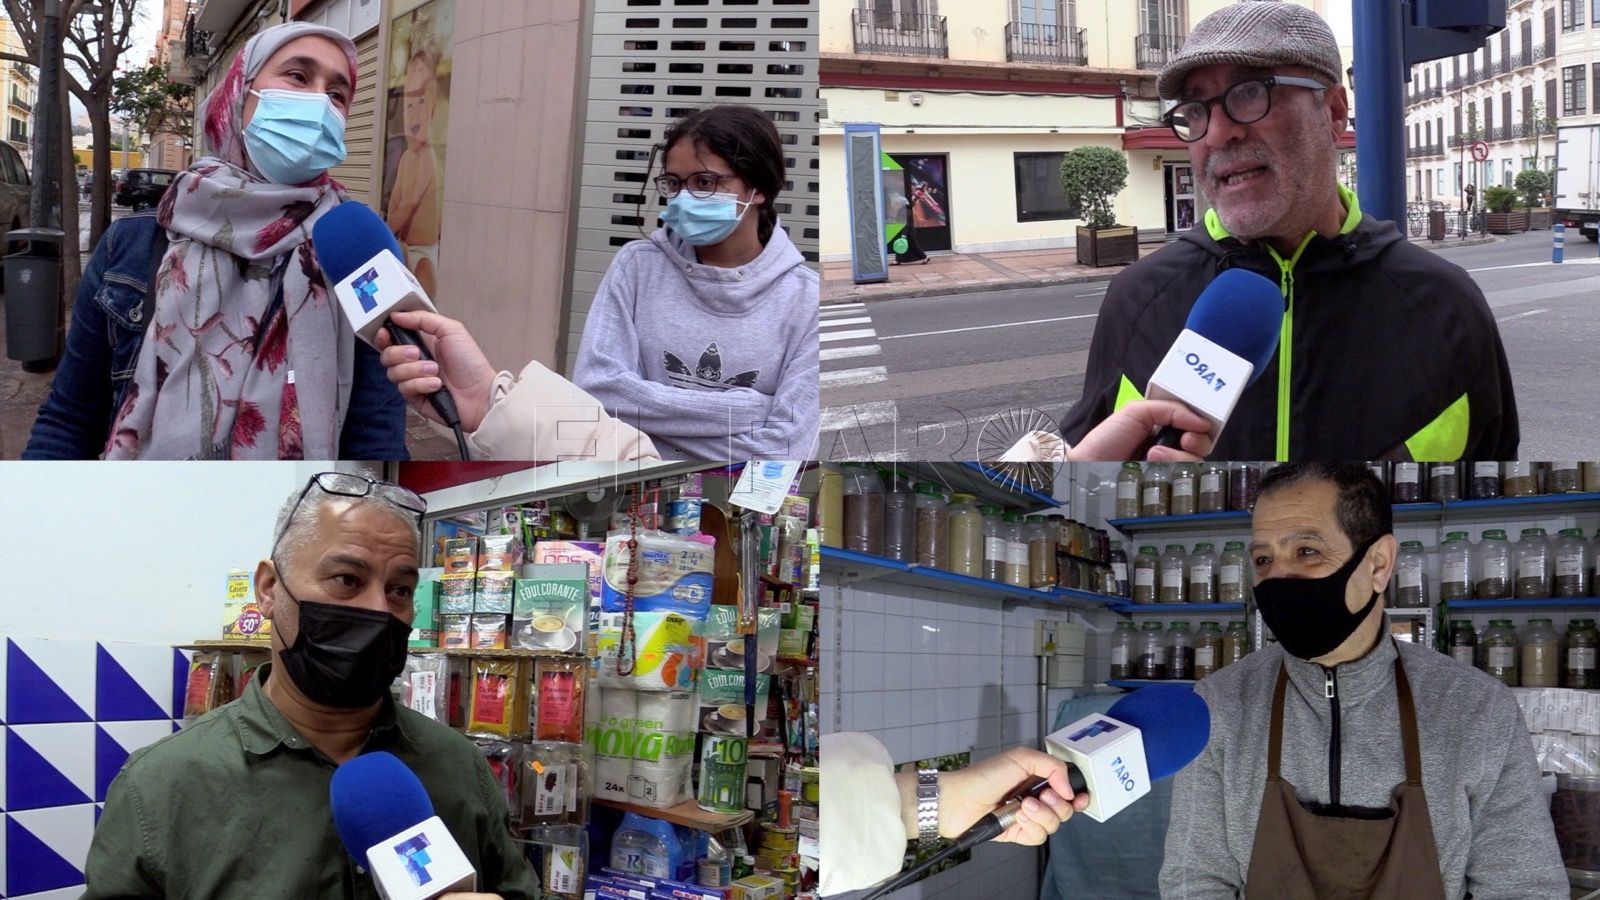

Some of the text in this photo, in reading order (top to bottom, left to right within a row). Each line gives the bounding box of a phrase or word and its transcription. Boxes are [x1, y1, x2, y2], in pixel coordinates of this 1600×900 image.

[519, 582, 580, 602] EDULCORANTE
[719, 740, 744, 763] 10
[604, 781, 625, 794] 24x
